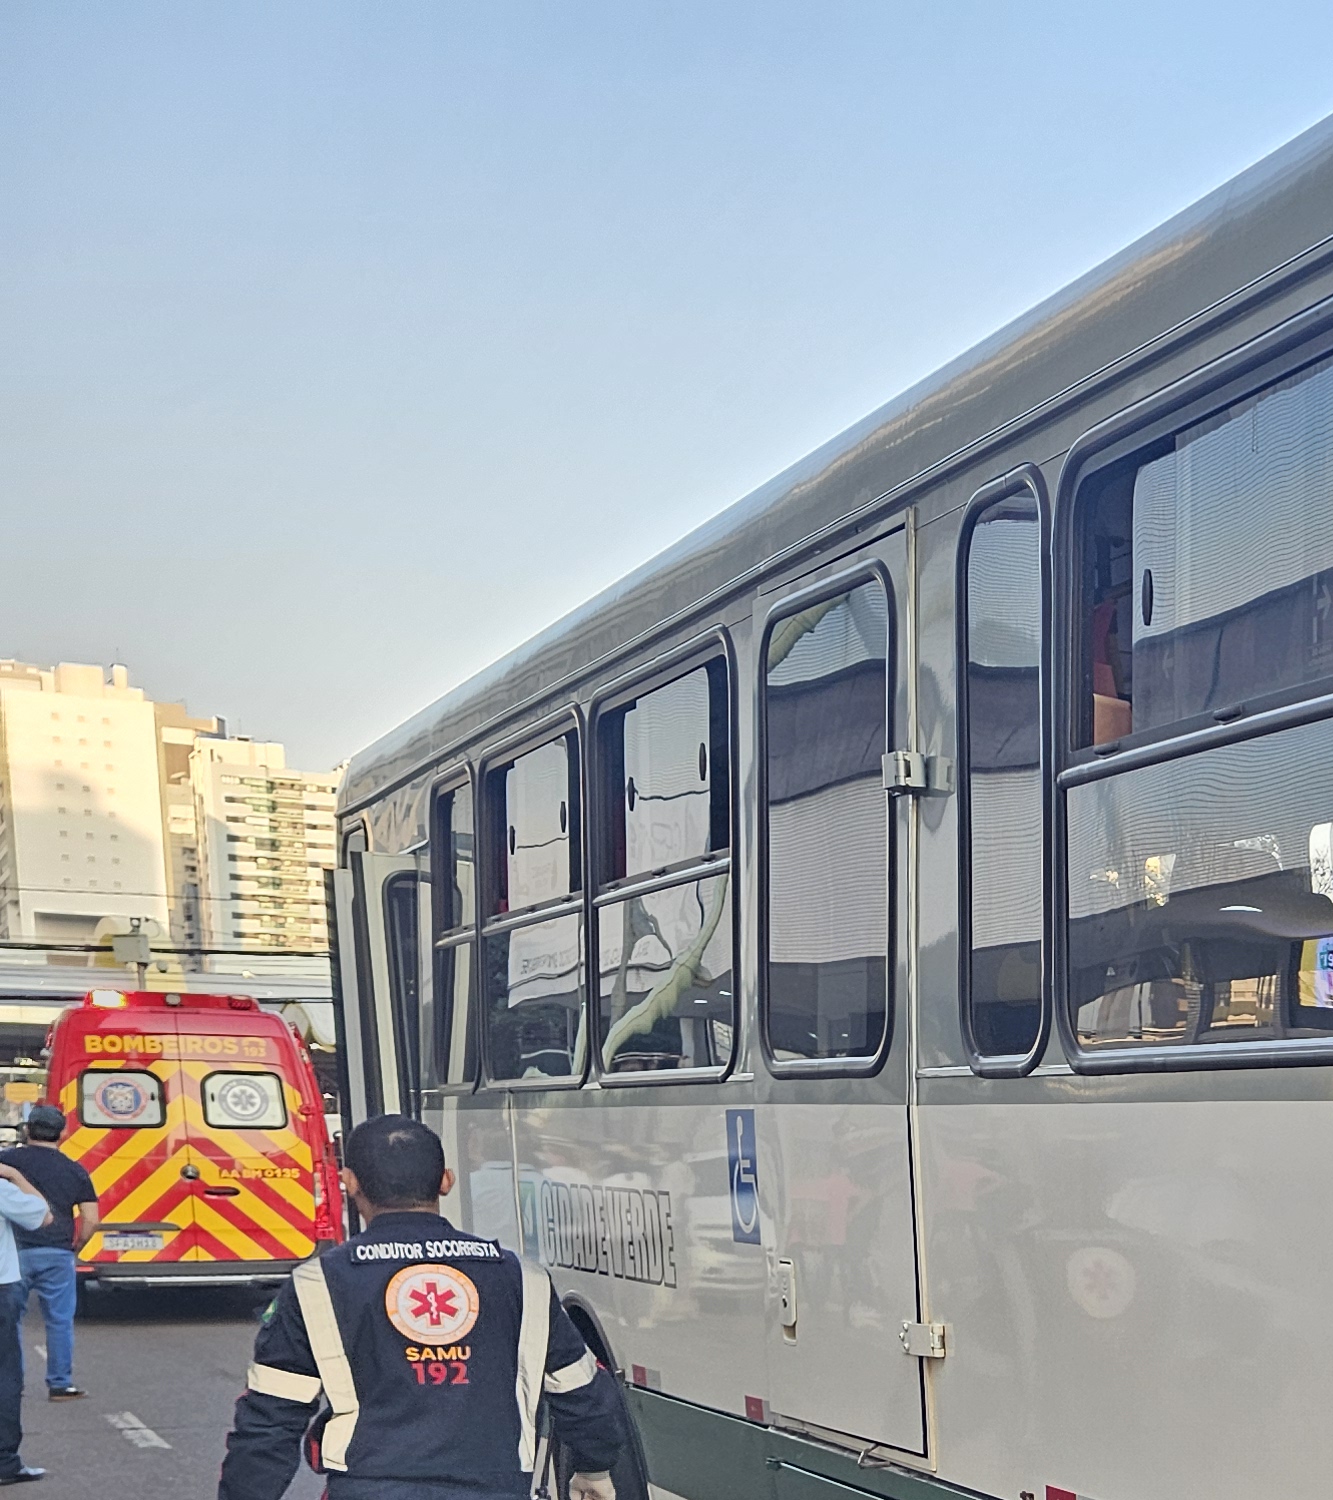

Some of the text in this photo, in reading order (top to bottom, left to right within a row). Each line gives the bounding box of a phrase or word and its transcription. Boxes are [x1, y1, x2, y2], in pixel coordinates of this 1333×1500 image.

[84, 1034, 239, 1054] BOMBEIROS
[244, 1047, 266, 1057] 193
[220, 1168, 241, 1179] AA
[264, 1168, 300, 1179] 0135
[356, 1240, 500, 1260] CONDUTOR SOCORRISTA
[405, 1346, 471, 1361] SAMU
[411, 1361, 470, 1385] 192
